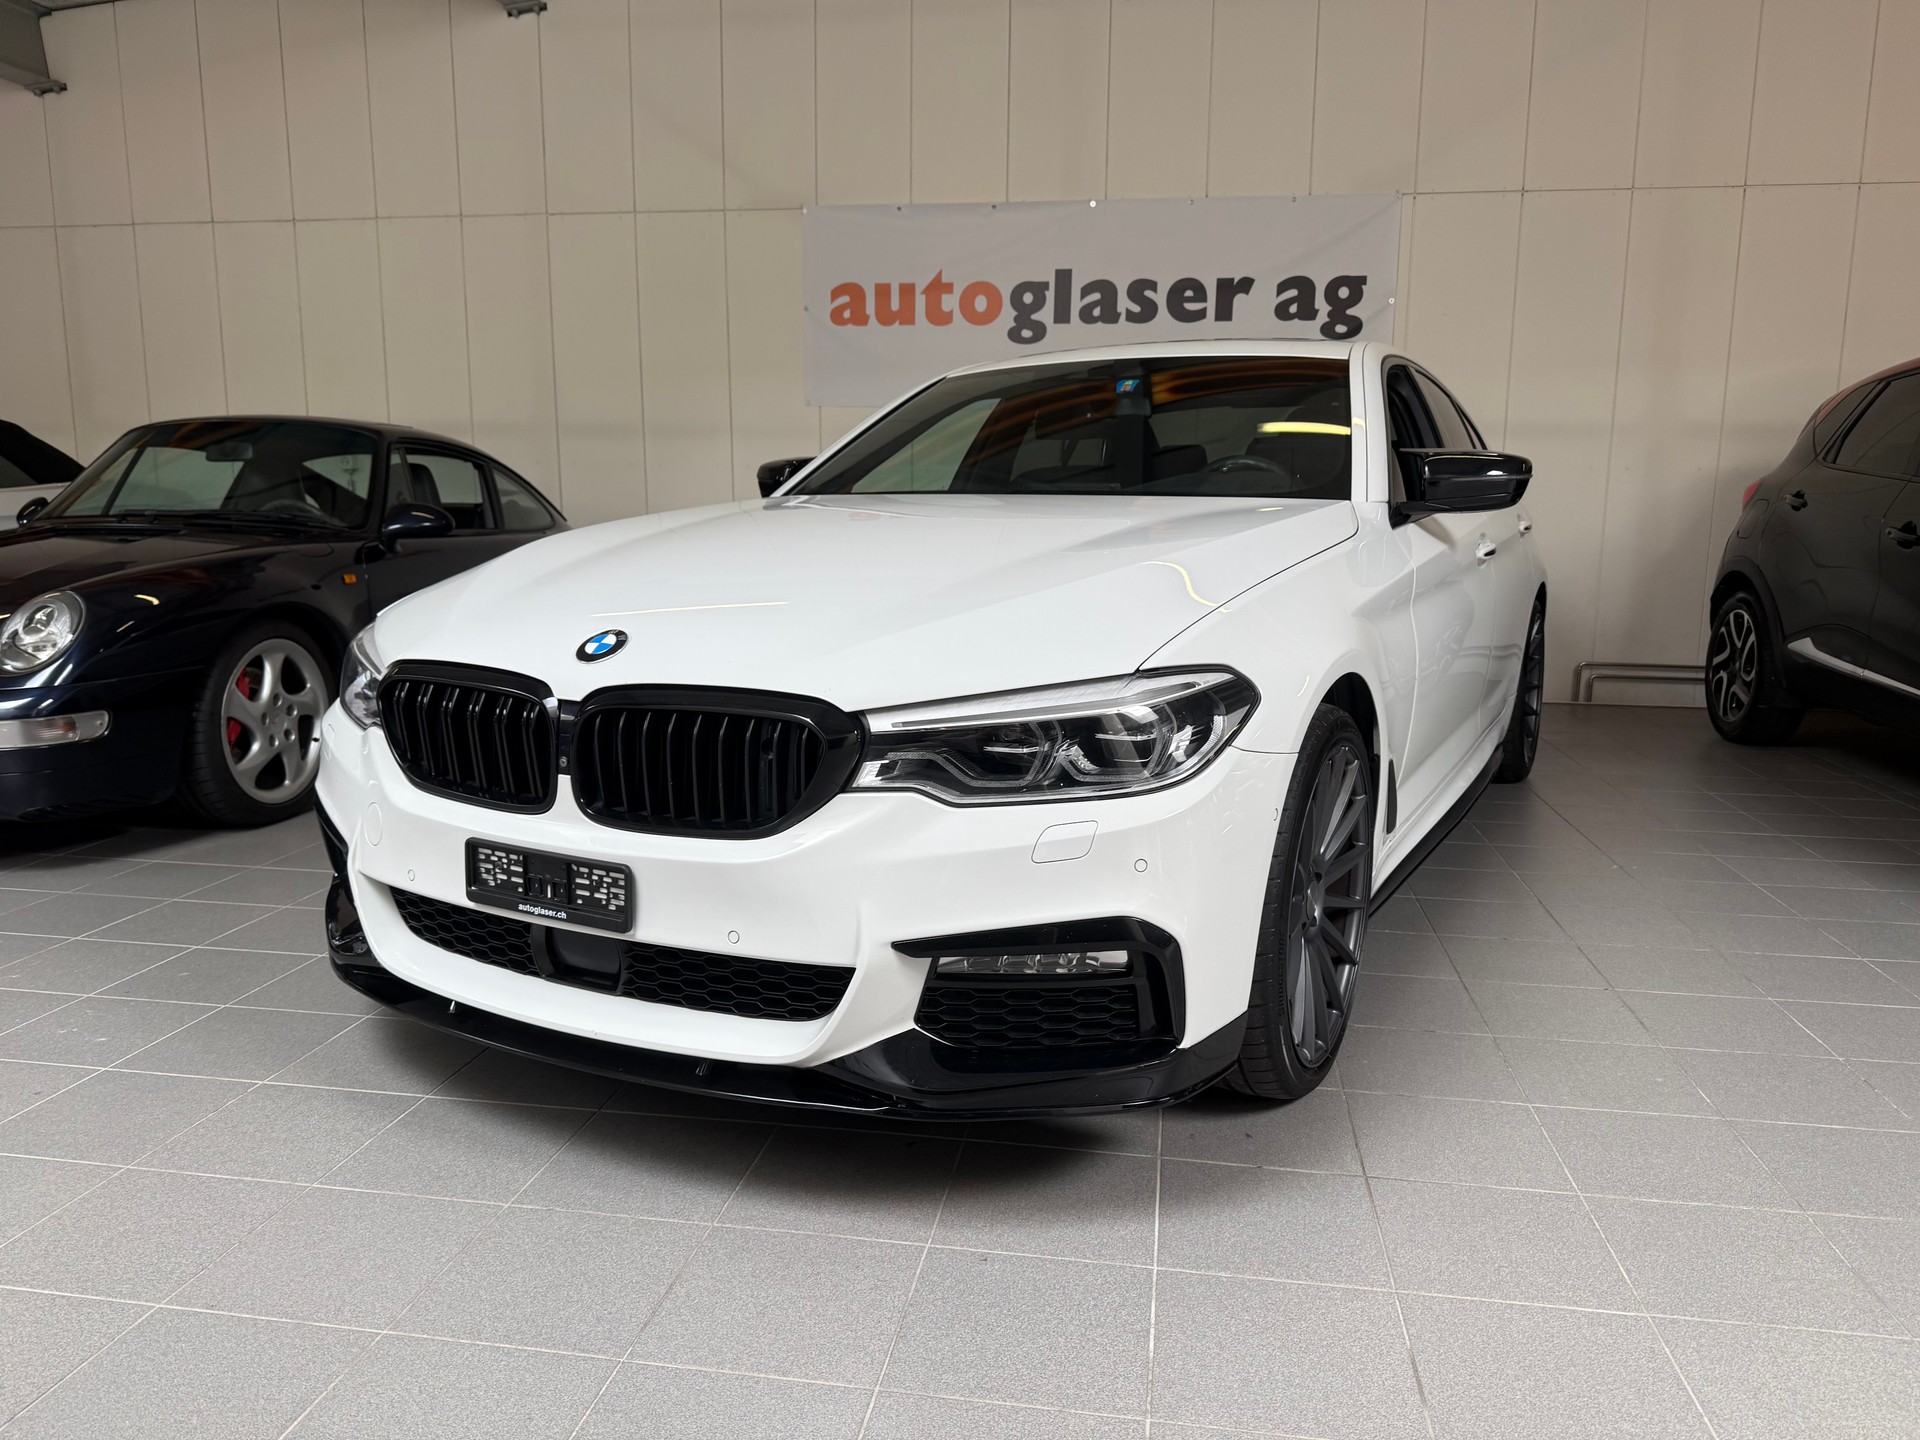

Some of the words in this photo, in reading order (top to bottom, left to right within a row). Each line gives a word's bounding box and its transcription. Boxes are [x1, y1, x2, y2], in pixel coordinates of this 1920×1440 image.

[830, 268, 1255, 345] autoglaser
[1274, 275, 1368, 341] ag
[518, 903, 567, 920] autoglaser.ch
